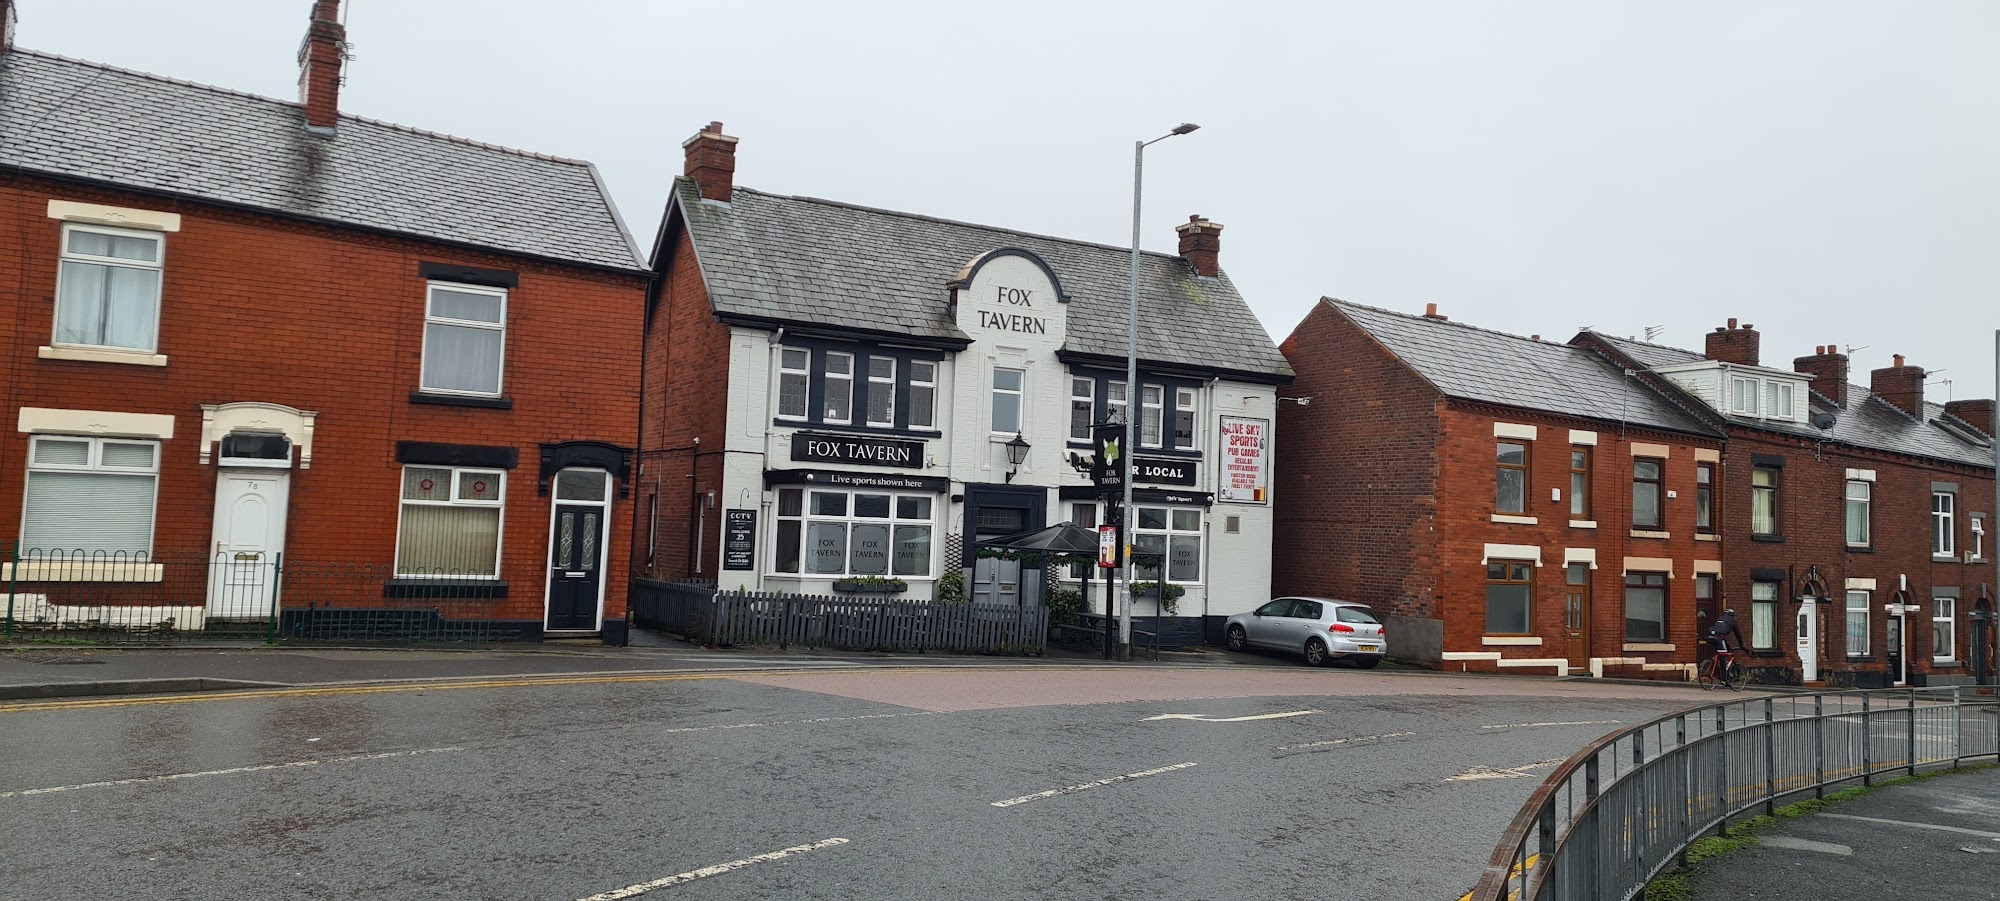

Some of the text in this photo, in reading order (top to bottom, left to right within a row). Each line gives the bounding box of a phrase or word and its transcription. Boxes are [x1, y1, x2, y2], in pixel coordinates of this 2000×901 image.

[997, 286, 1032, 307] FOX
[977, 310, 1046, 335] TAVERN
[1228, 422, 1260, 436] LIVE SKY
[1230, 435, 1258, 448] SPORTS
[807, 440, 911, 462] FOX TAVERN
[1228, 447, 1260, 458] PUB GAMES
[1105, 469, 1116, 477] FOX
[1145, 466, 1184, 478] LOCAL
[831, 474, 923, 488] Live sports shown here
[1101, 476, 1121, 485] TAVERN
[247, 481, 258, 490] 78
[730, 512, 752, 520] CCTV
[736, 533, 745, 541] 25
[818, 539, 835, 547] FOX
[862, 540, 878, 548] FOX
[904, 541, 920, 549] FOX
[810, 549, 841, 557] TAVERN
[854, 550, 884, 558] TAVERN
[1178, 550, 1191, 558] FOX
[1172, 559, 1196, 567] TAVERN
